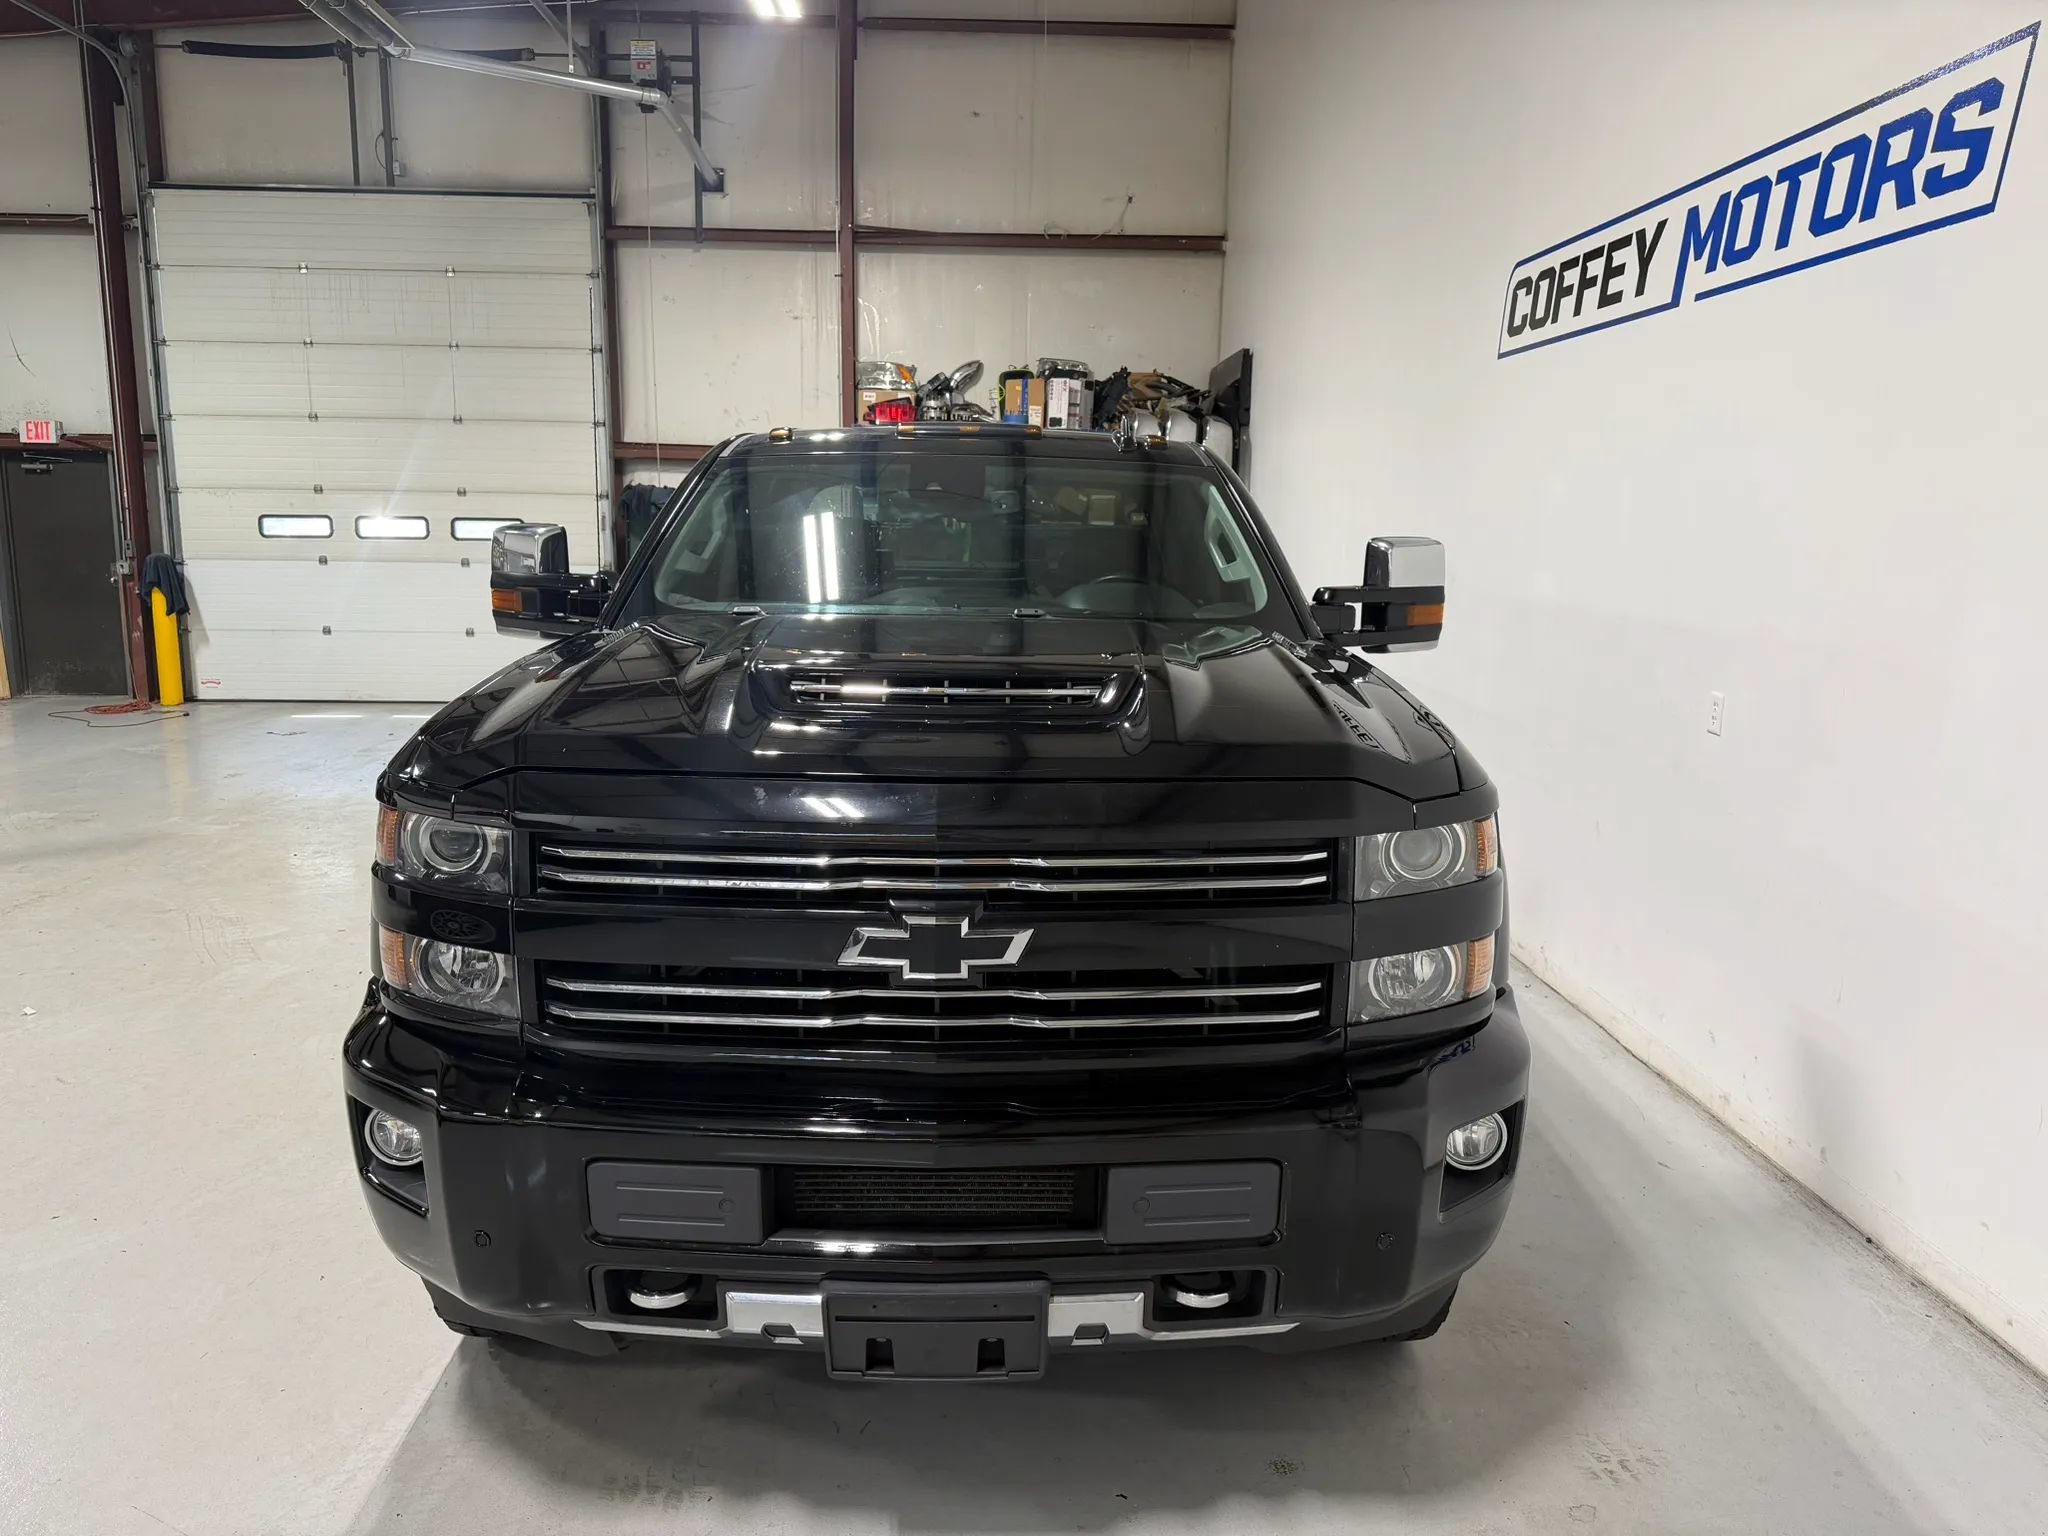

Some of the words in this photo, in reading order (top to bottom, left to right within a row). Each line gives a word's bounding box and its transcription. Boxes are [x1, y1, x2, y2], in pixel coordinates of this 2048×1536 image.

[1507, 217, 1669, 338] COFFEY
[1671, 76, 2005, 305] MOTORS
[26, 421, 50, 440] EXIT
